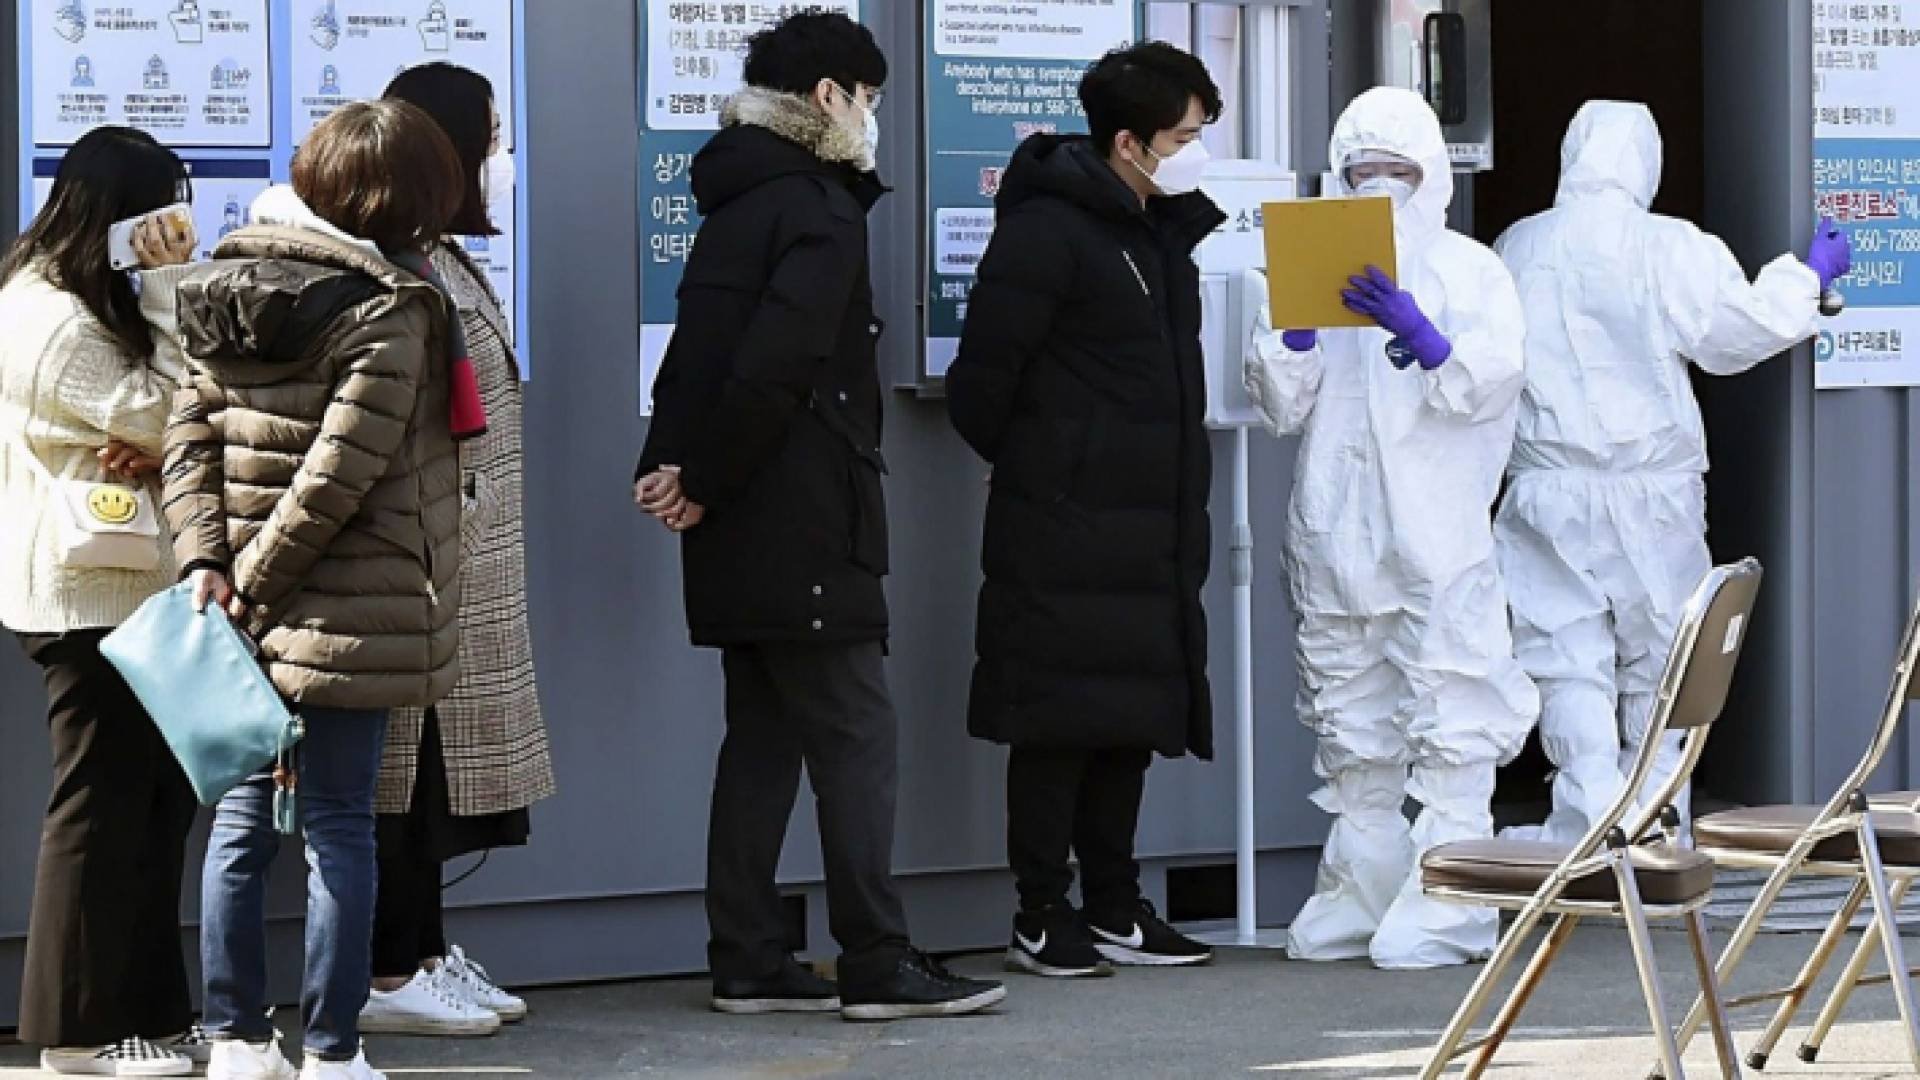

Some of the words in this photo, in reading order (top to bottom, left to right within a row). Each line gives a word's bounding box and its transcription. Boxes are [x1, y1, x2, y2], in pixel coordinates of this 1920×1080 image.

[944, 62, 990, 81] Anybody
[993, 65, 1014, 79] who
[1016, 65, 1036, 79] has
[1039, 66, 1086, 83] symptom
[956, 81, 1009, 96] described
[1012, 82, 1022, 96] is
[1023, 83, 1063, 98] allowed
[1064, 83, 1079, 98] to
[1031, 101, 1044, 115] or
[1046, 99, 1088, 117] 560-72
[651, 196, 698, 225] 이곳
[650, 232, 697, 264] 인터
[1838, 329, 1902, 352] 대구의료원
